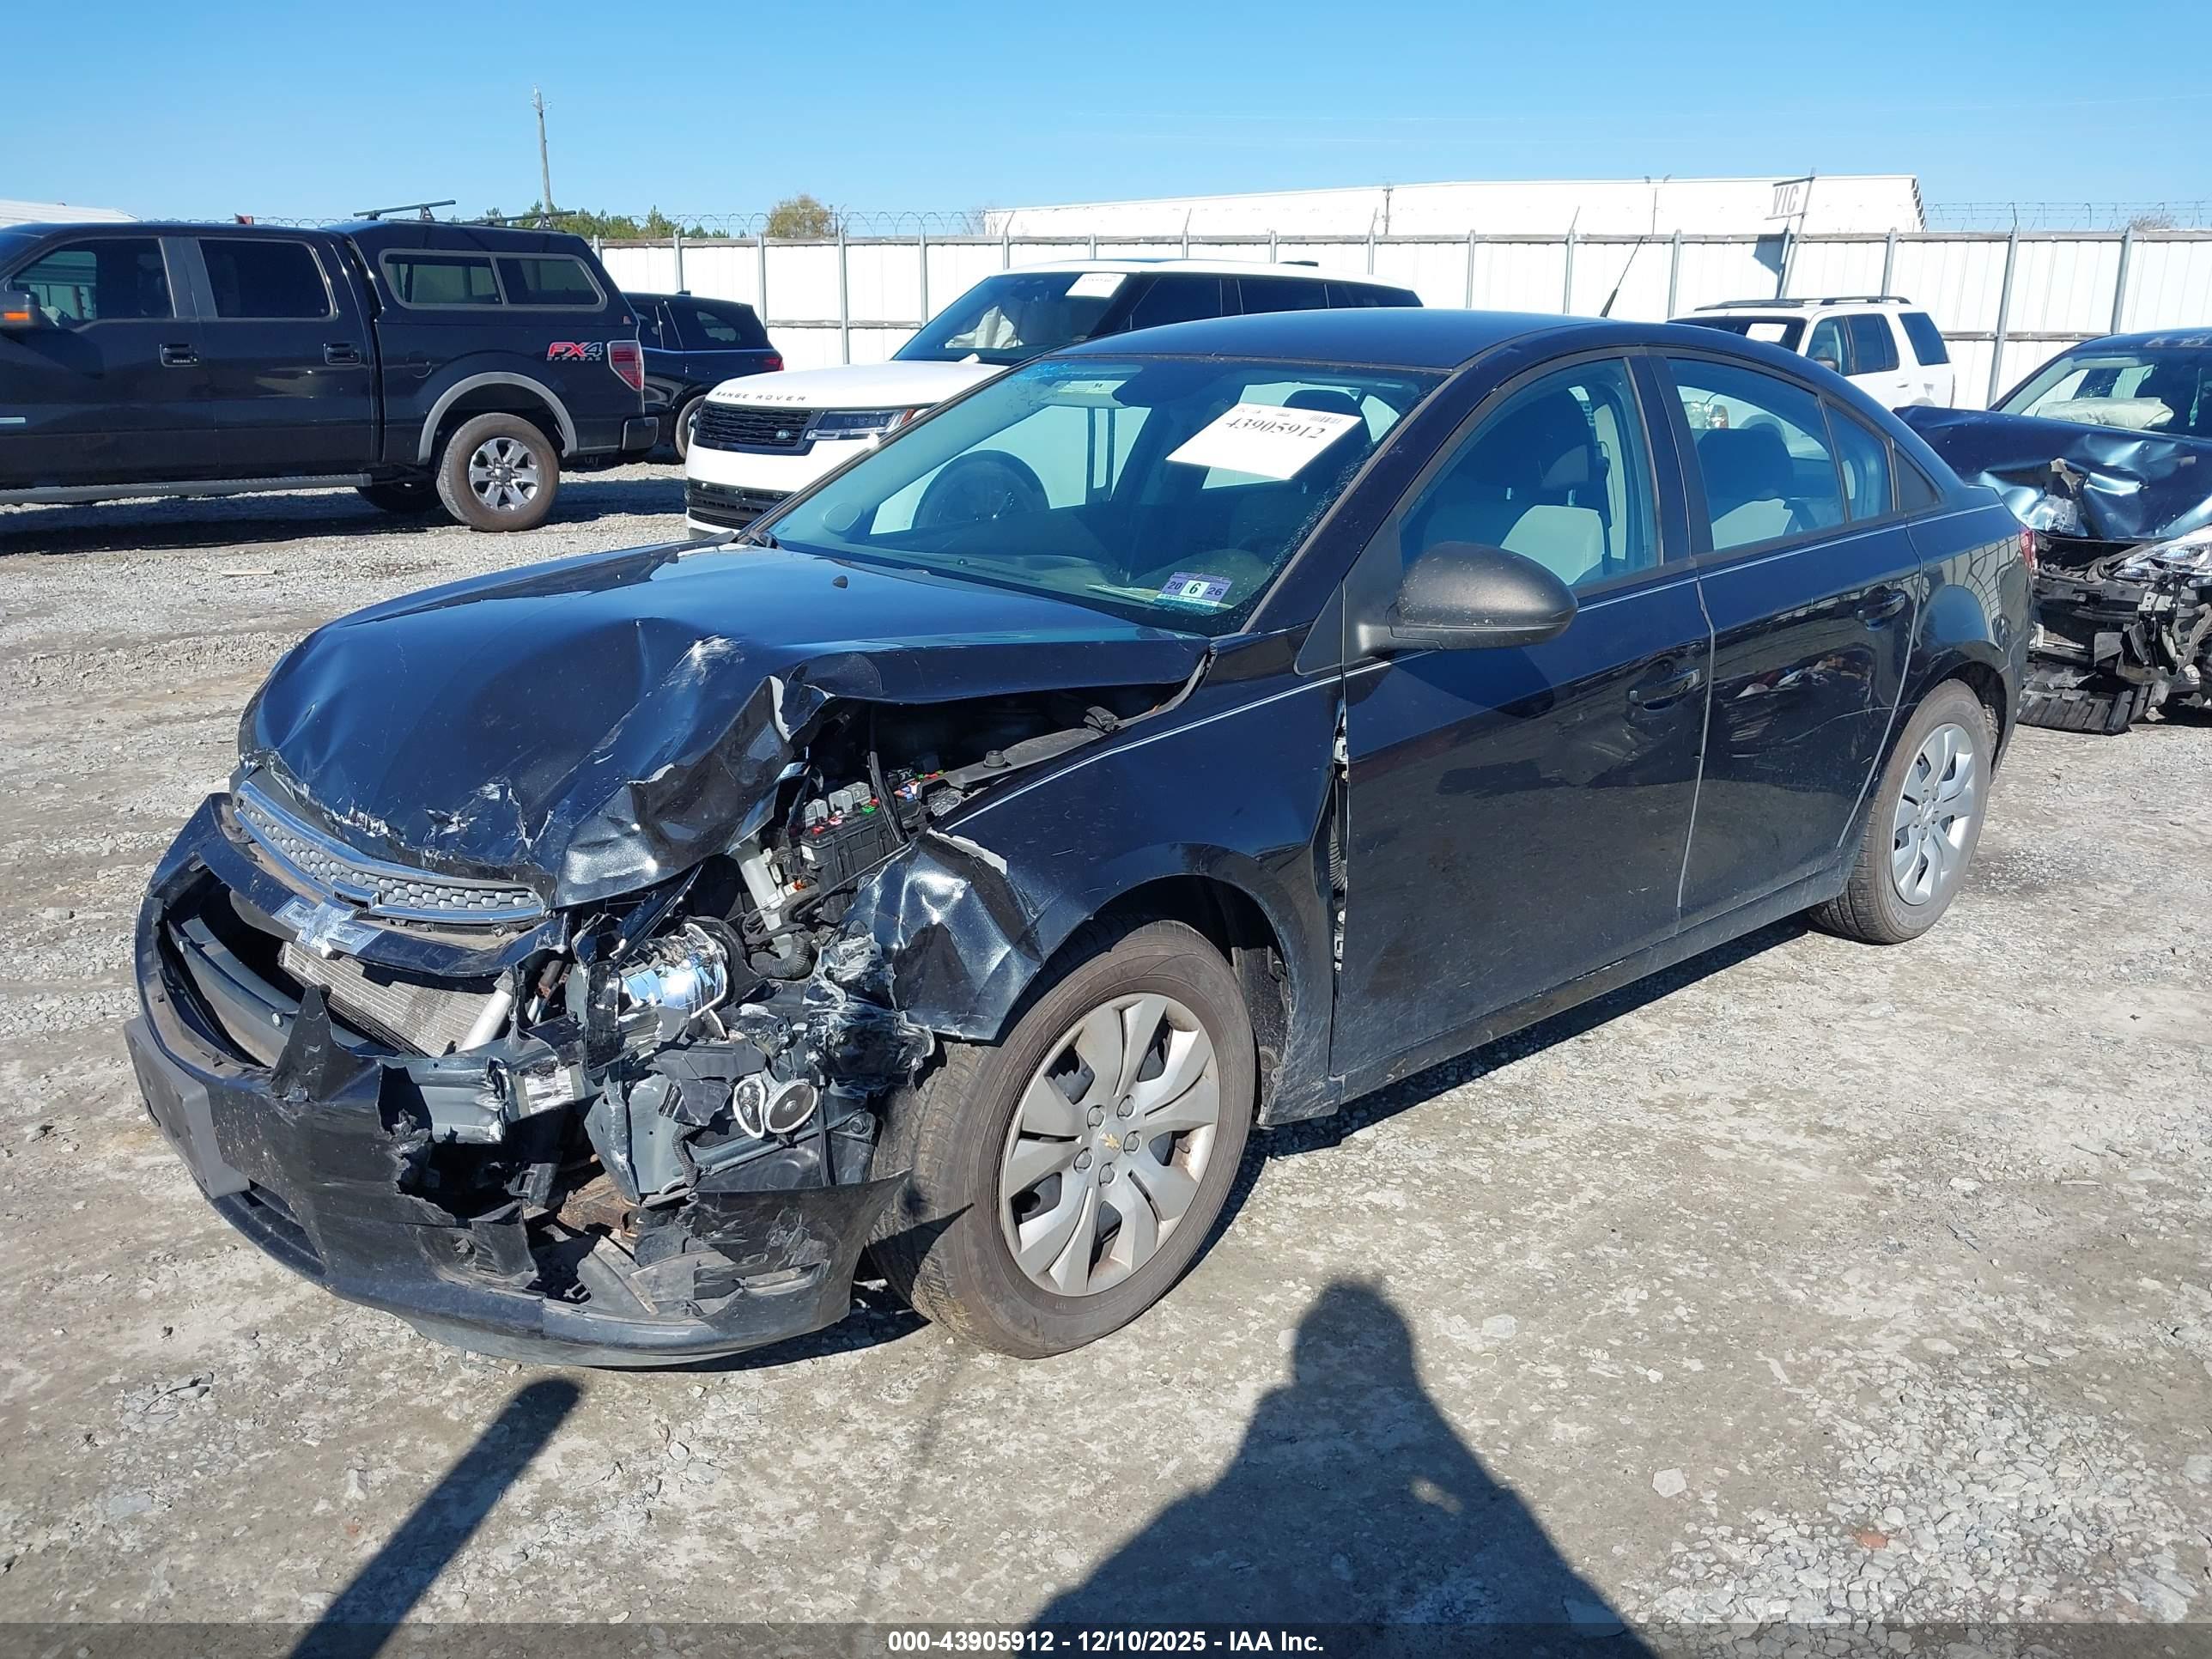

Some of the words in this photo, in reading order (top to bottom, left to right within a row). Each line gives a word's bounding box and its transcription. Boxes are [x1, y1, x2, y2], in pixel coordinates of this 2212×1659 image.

[1772, 185, 1799, 215] VIC
[547, 342, 603, 357] FX4
[716, 392, 749, 400] RANGE
[1226, 417, 1326, 439] 43905912
[1168, 581, 1182, 590] 20
[1189, 582, 1201, 594] 6
[1206, 587, 1223, 596] 26
